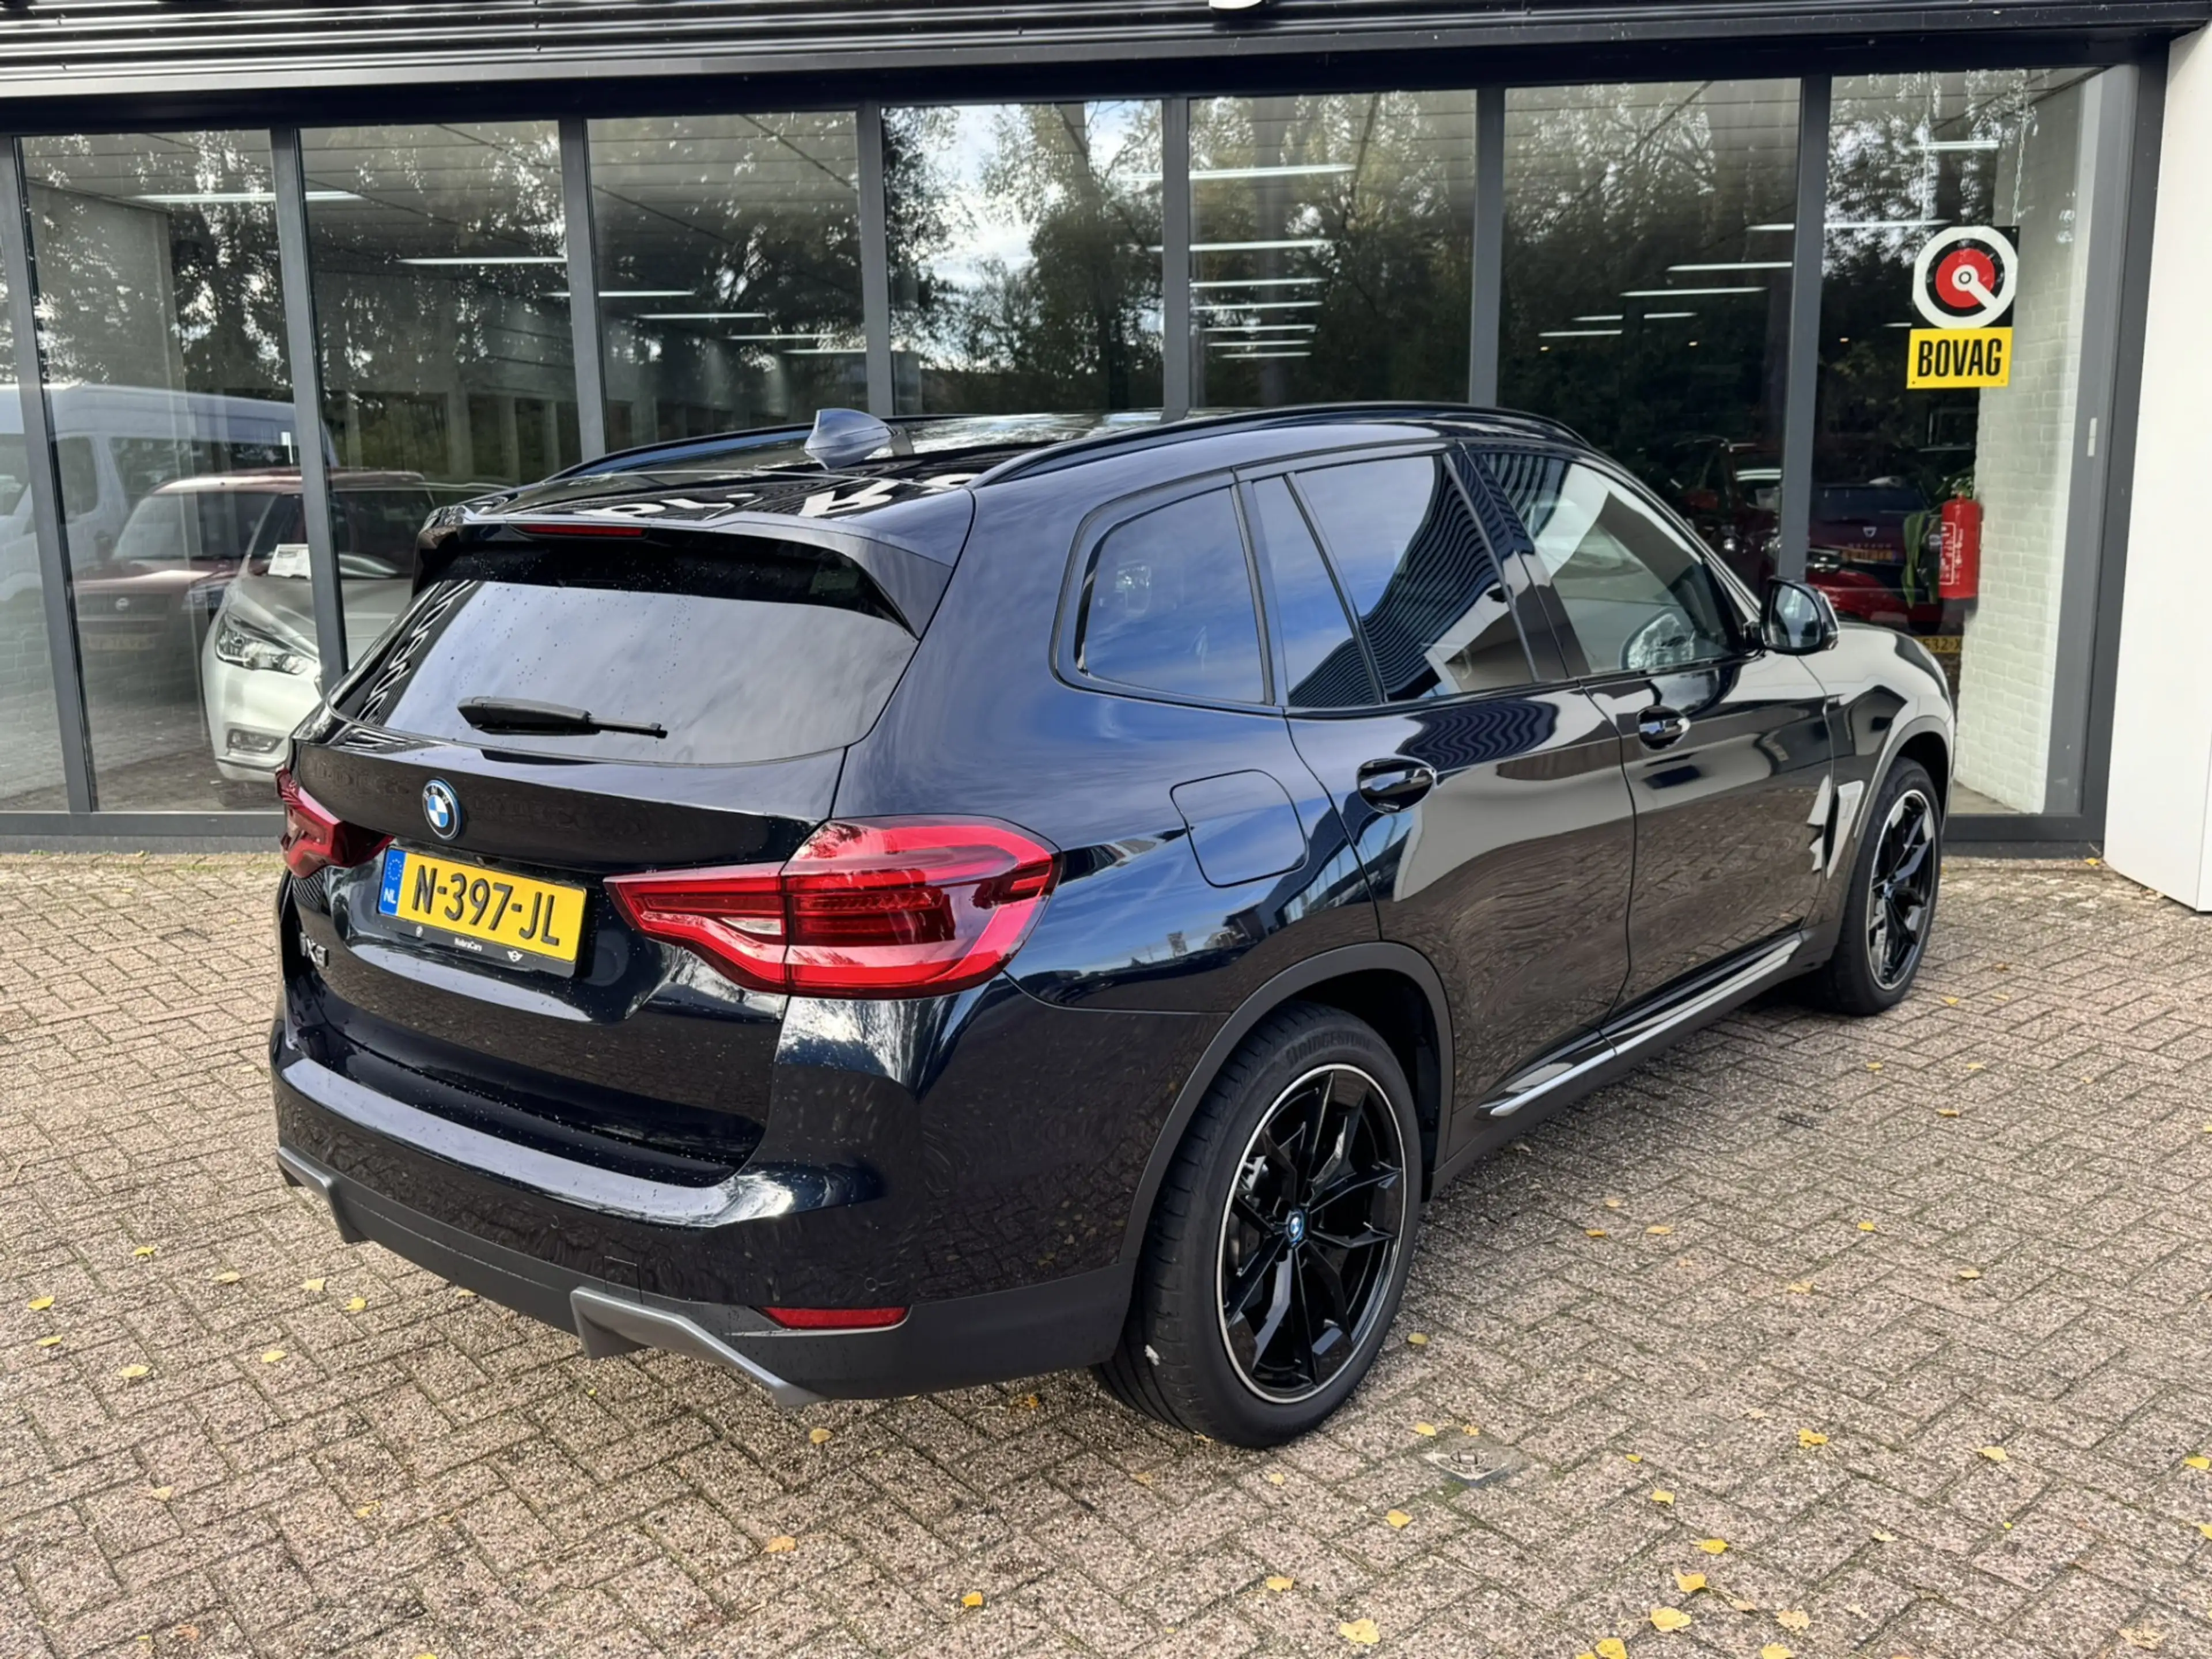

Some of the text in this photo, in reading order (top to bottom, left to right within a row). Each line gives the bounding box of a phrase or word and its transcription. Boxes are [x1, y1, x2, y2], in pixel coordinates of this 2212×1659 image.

[1917, 338, 2002, 377] BOVAG
[423, 785, 450, 804] BMW
[384, 888, 396, 904] NL
[412, 865, 560, 946] N-397-JL
